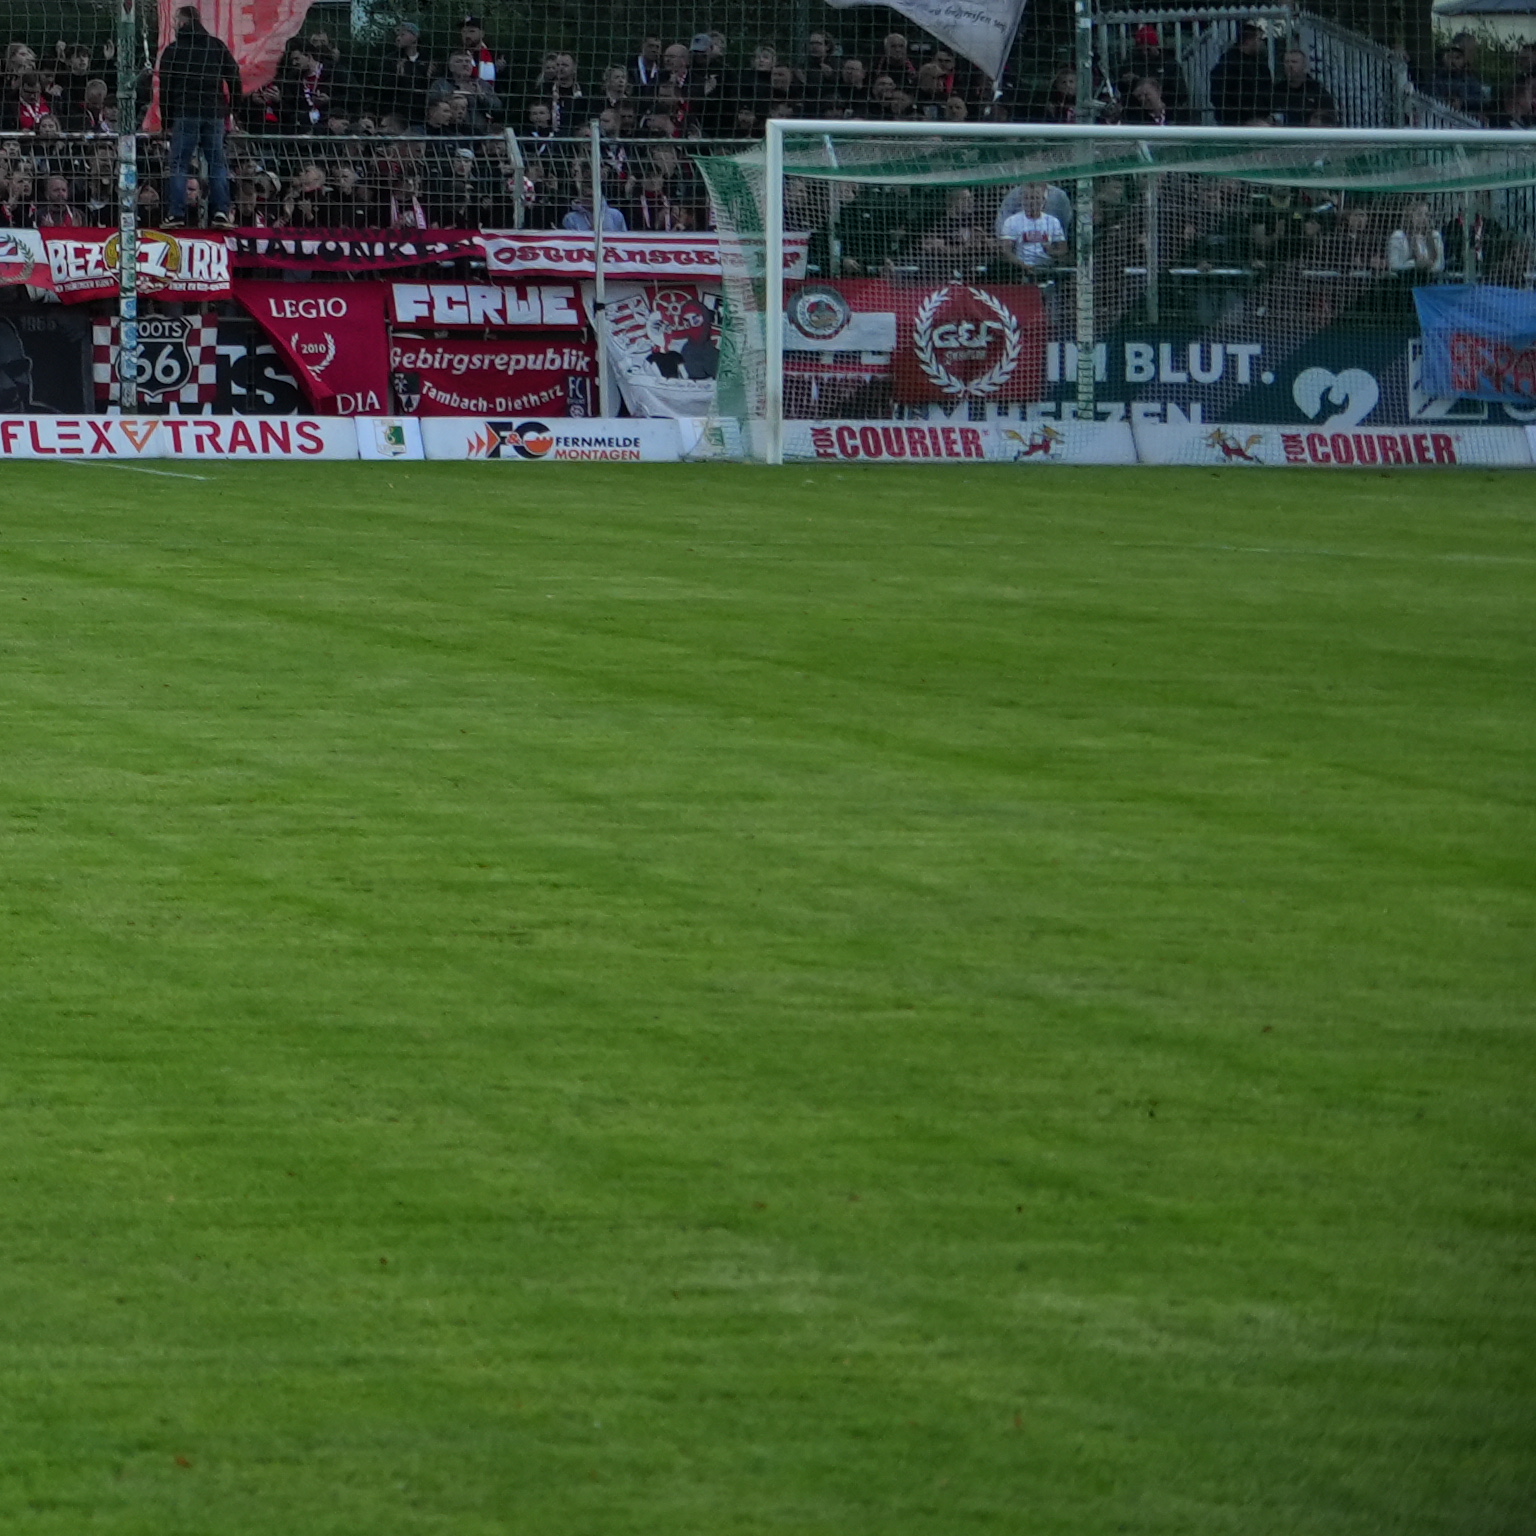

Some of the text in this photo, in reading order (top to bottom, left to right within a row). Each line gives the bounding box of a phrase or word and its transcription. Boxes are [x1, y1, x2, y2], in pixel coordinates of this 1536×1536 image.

[268, 297, 347, 319] LEGIO
[136, 321, 182, 338] OOTS
[301, 343, 327, 355] 2010
[390, 348, 592, 376] Gebirgsrepublik
[1124, 342, 1275, 386] BLUT.
[422, 379, 565, 413] Tambach-Dietharz
[0, 419, 324, 455] FLEX TRANS
[555, 437, 640, 448] FERNMELDE
[836, 426, 984, 459] COURIER
[1307, 432, 1457, 465] COURIER
[554, 449, 640, 461] MONTAGEN
